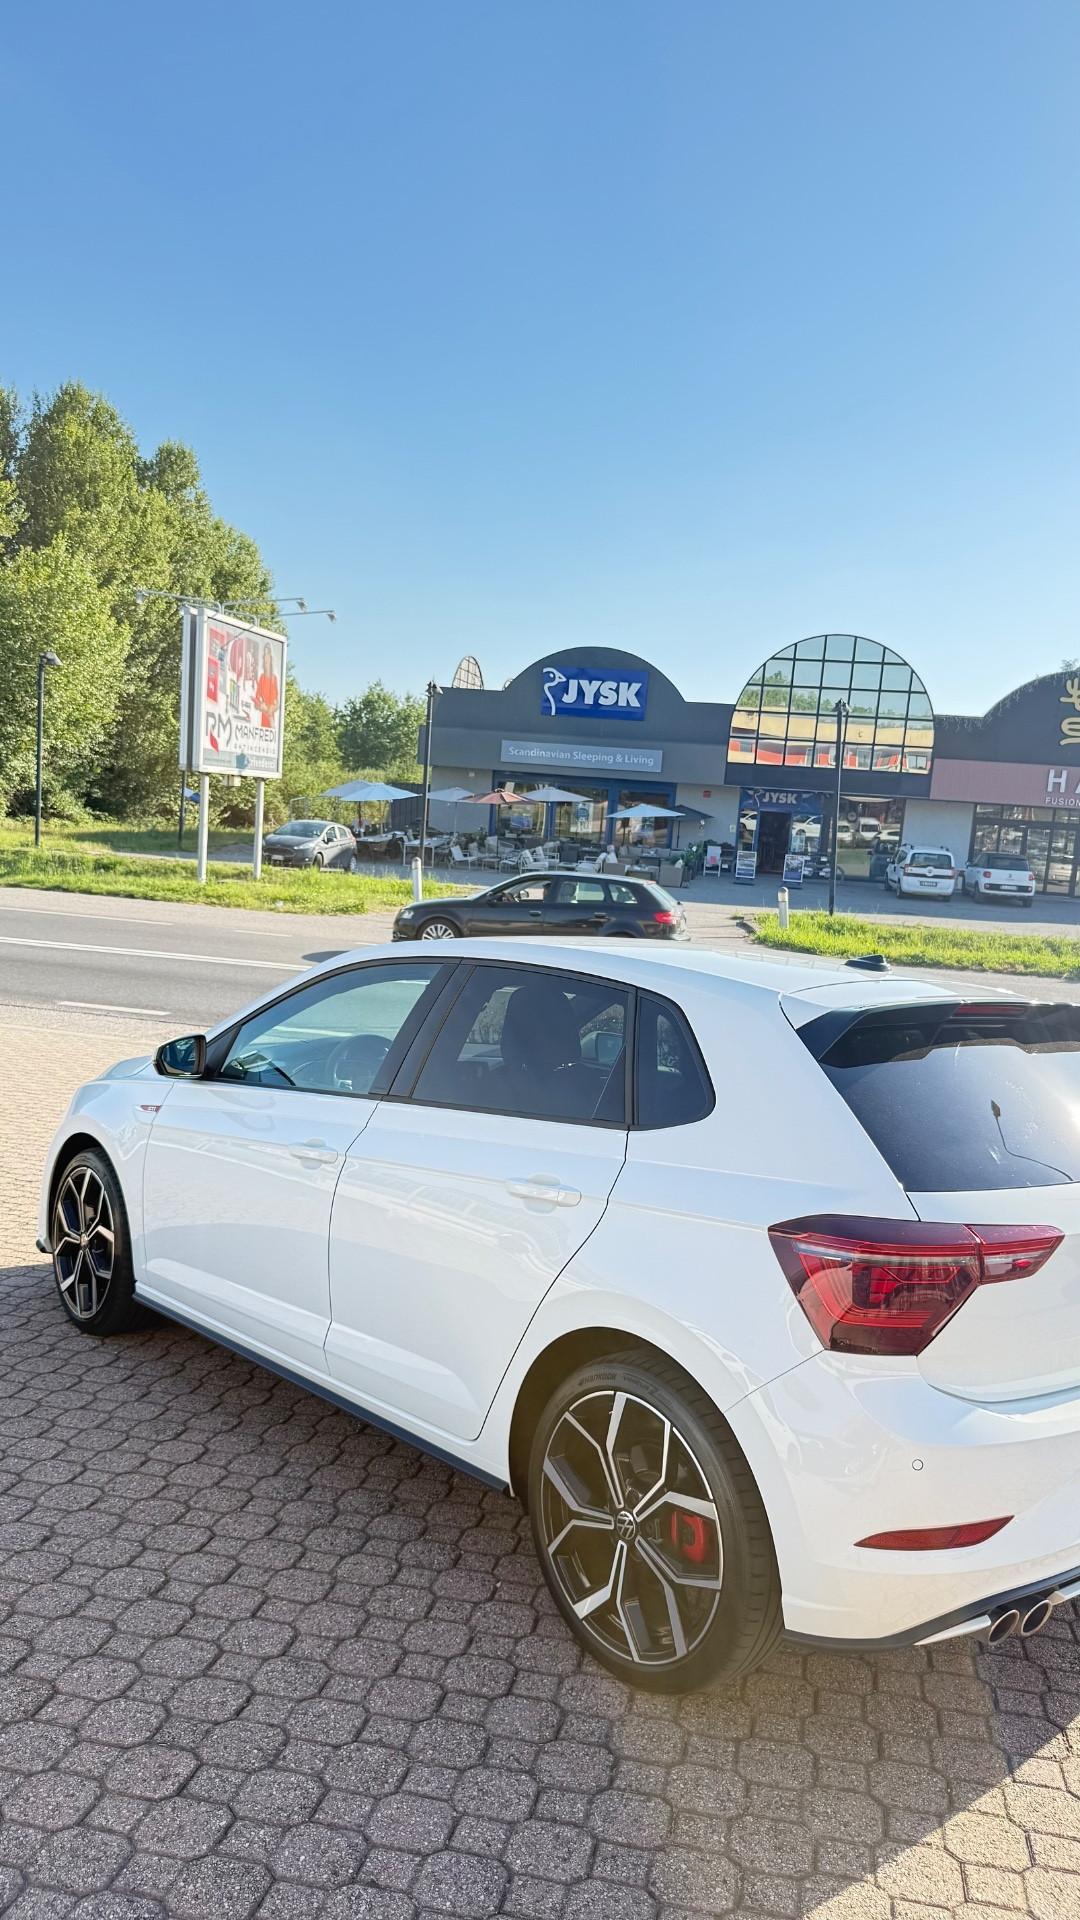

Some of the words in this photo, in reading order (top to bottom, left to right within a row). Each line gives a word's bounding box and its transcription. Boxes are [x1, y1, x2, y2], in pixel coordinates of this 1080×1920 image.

[562, 679, 642, 708] JYSK
[235, 724, 277, 743] MANFREDI
[508, 746, 571, 760] Scandinavian
[573, 751, 614, 764] Sleeping
[616, 754, 624, 762] &
[625, 754, 654, 766] Living
[762, 792, 797, 804] JYSK
